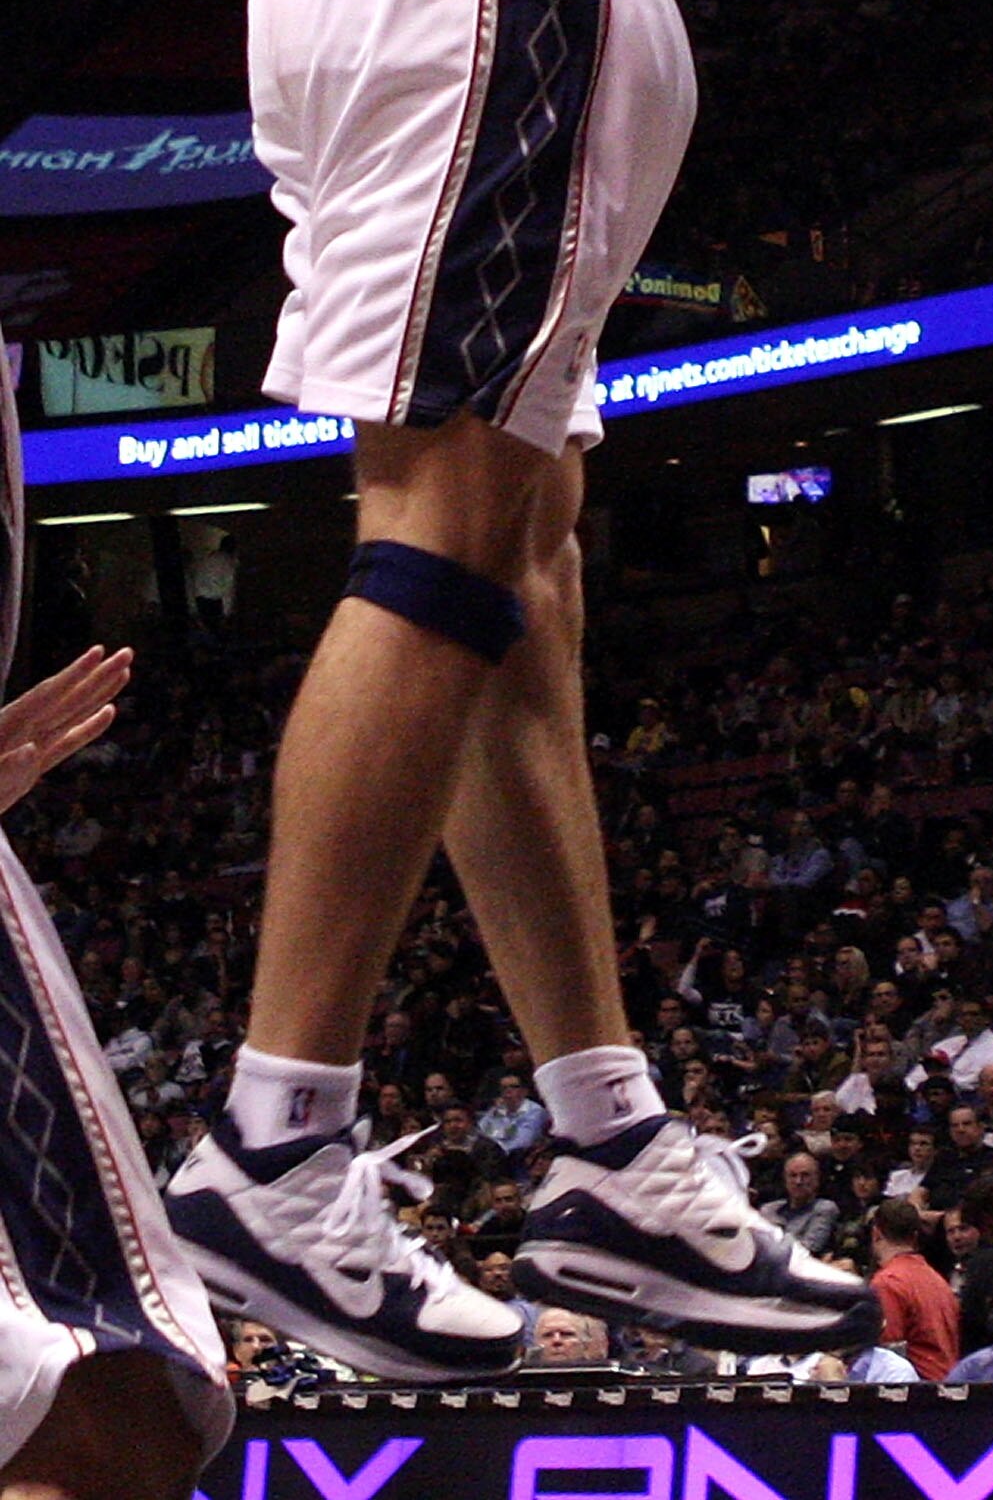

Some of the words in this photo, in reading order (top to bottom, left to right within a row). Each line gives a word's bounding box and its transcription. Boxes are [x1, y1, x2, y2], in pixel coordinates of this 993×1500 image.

[610, 374, 635, 403] at
[118, 435, 168, 469] Buy
[171, 427, 220, 460] and
[222, 421, 261, 455] sell
[262, 416, 338, 449] tickets
